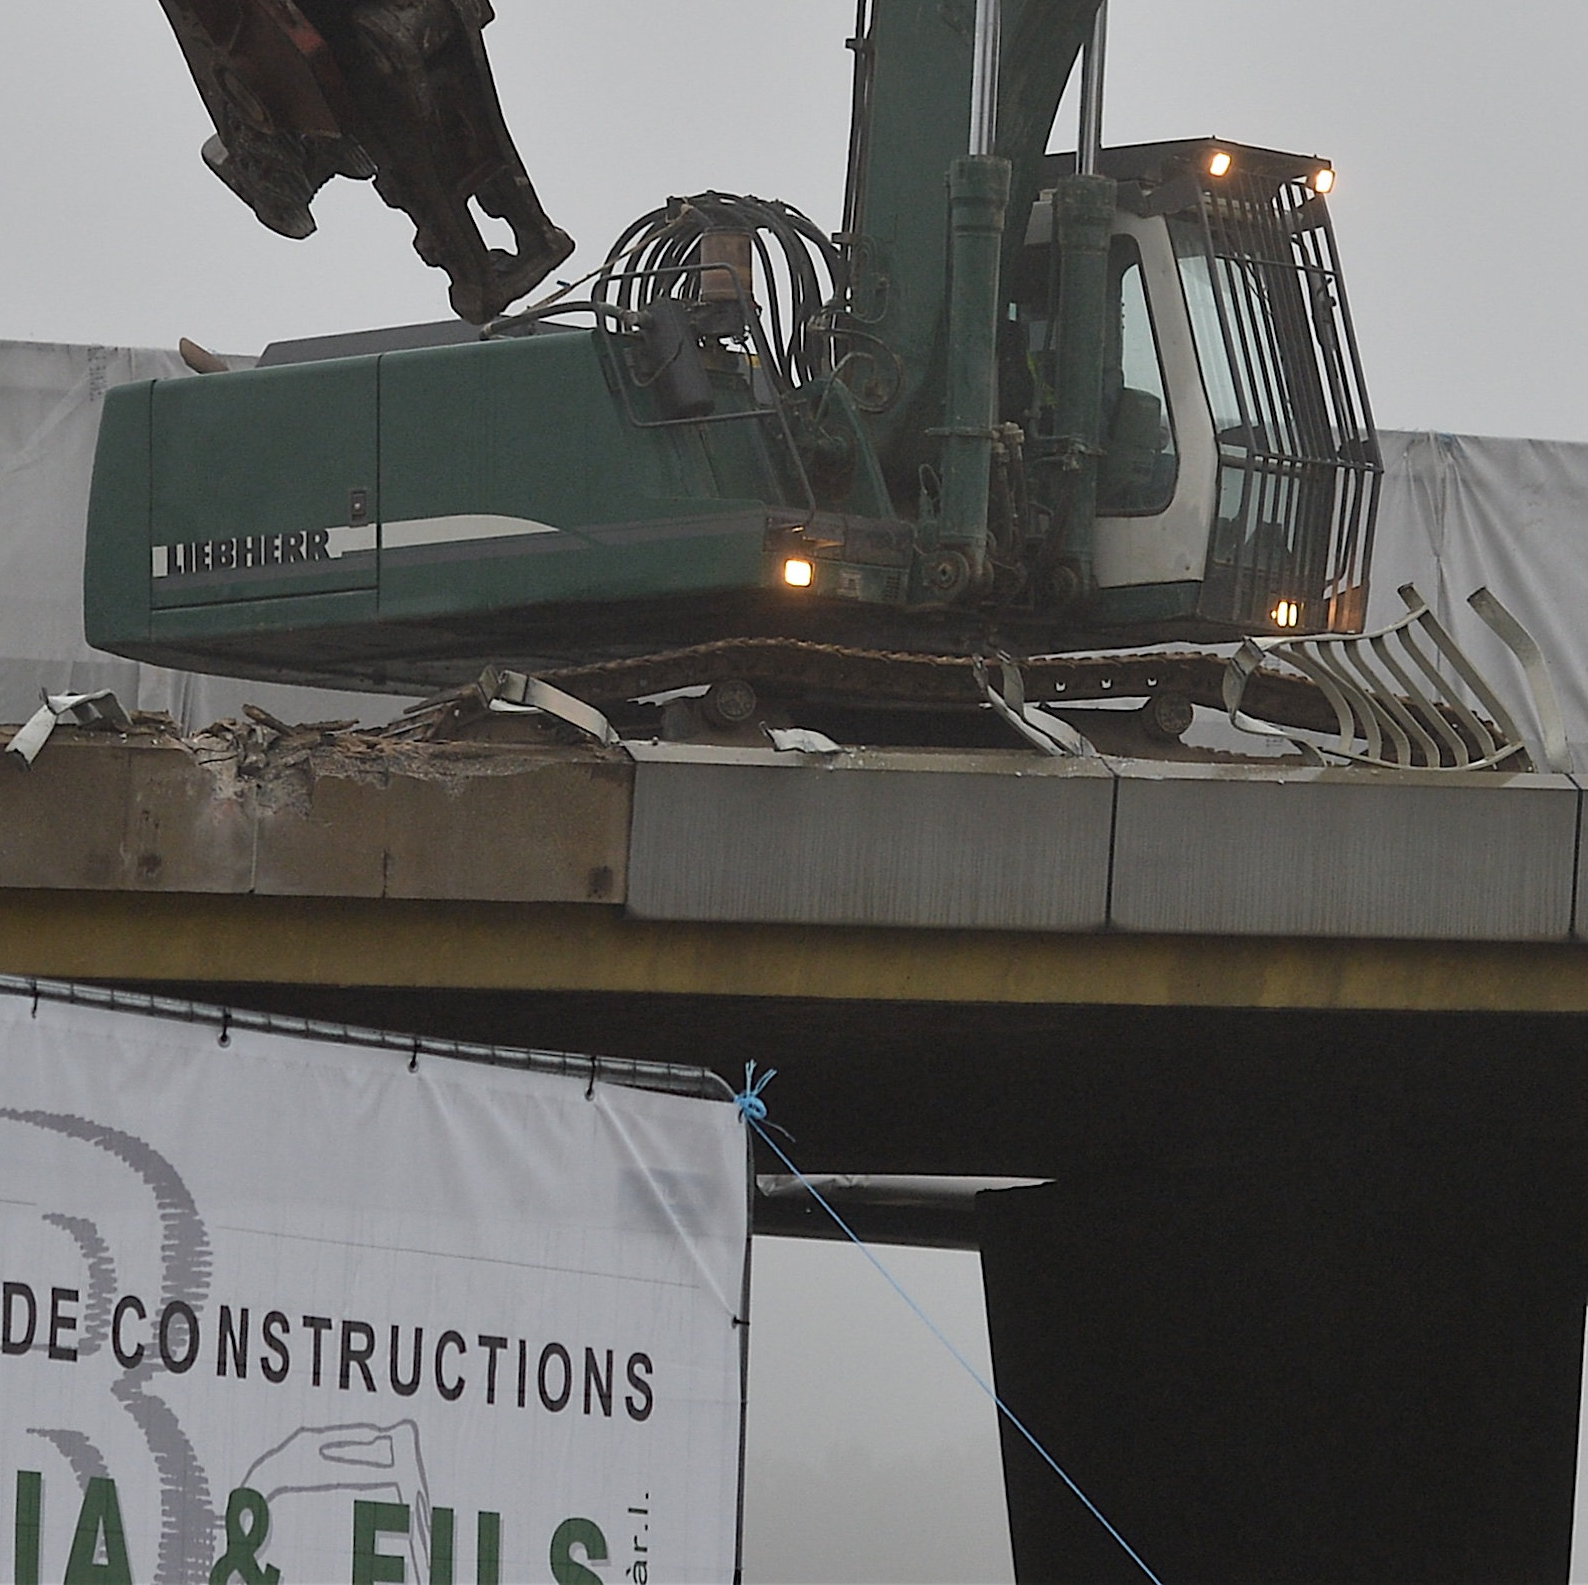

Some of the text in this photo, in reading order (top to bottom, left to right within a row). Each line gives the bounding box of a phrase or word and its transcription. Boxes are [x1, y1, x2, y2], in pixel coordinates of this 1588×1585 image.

[168, 529, 331, 575] LIEBHERR
[1, 1280, 80, 1363] DE
[112, 1295, 654, 1422] CONSTRUCTIONS
[210, 1486, 282, 1585] &
